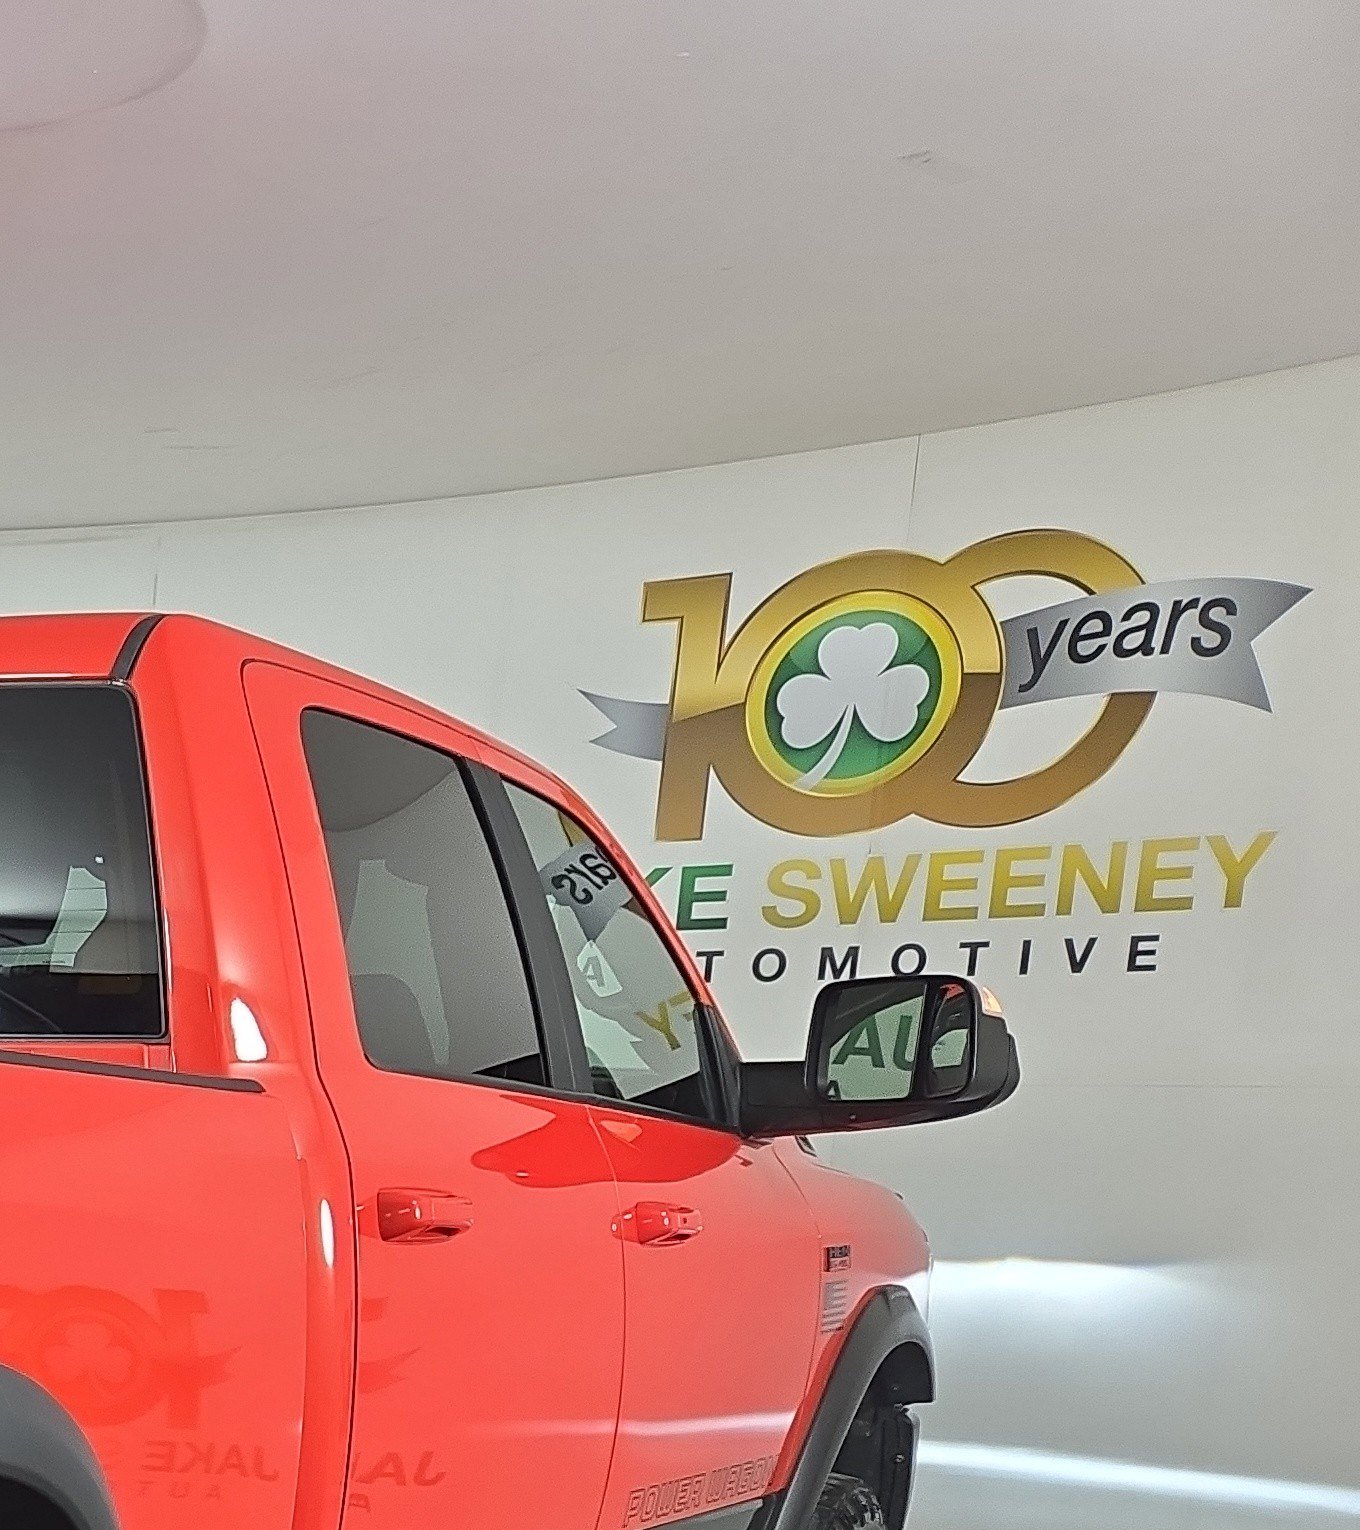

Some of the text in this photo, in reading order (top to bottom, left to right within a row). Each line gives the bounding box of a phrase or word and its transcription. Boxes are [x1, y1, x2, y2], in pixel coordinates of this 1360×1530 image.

[641, 528, 1158, 842] 100
[1017, 595, 1237, 692] years
[761, 830, 1278, 929] SWEENEY
[695, 933, 1162, 983] TOMOTIVE
